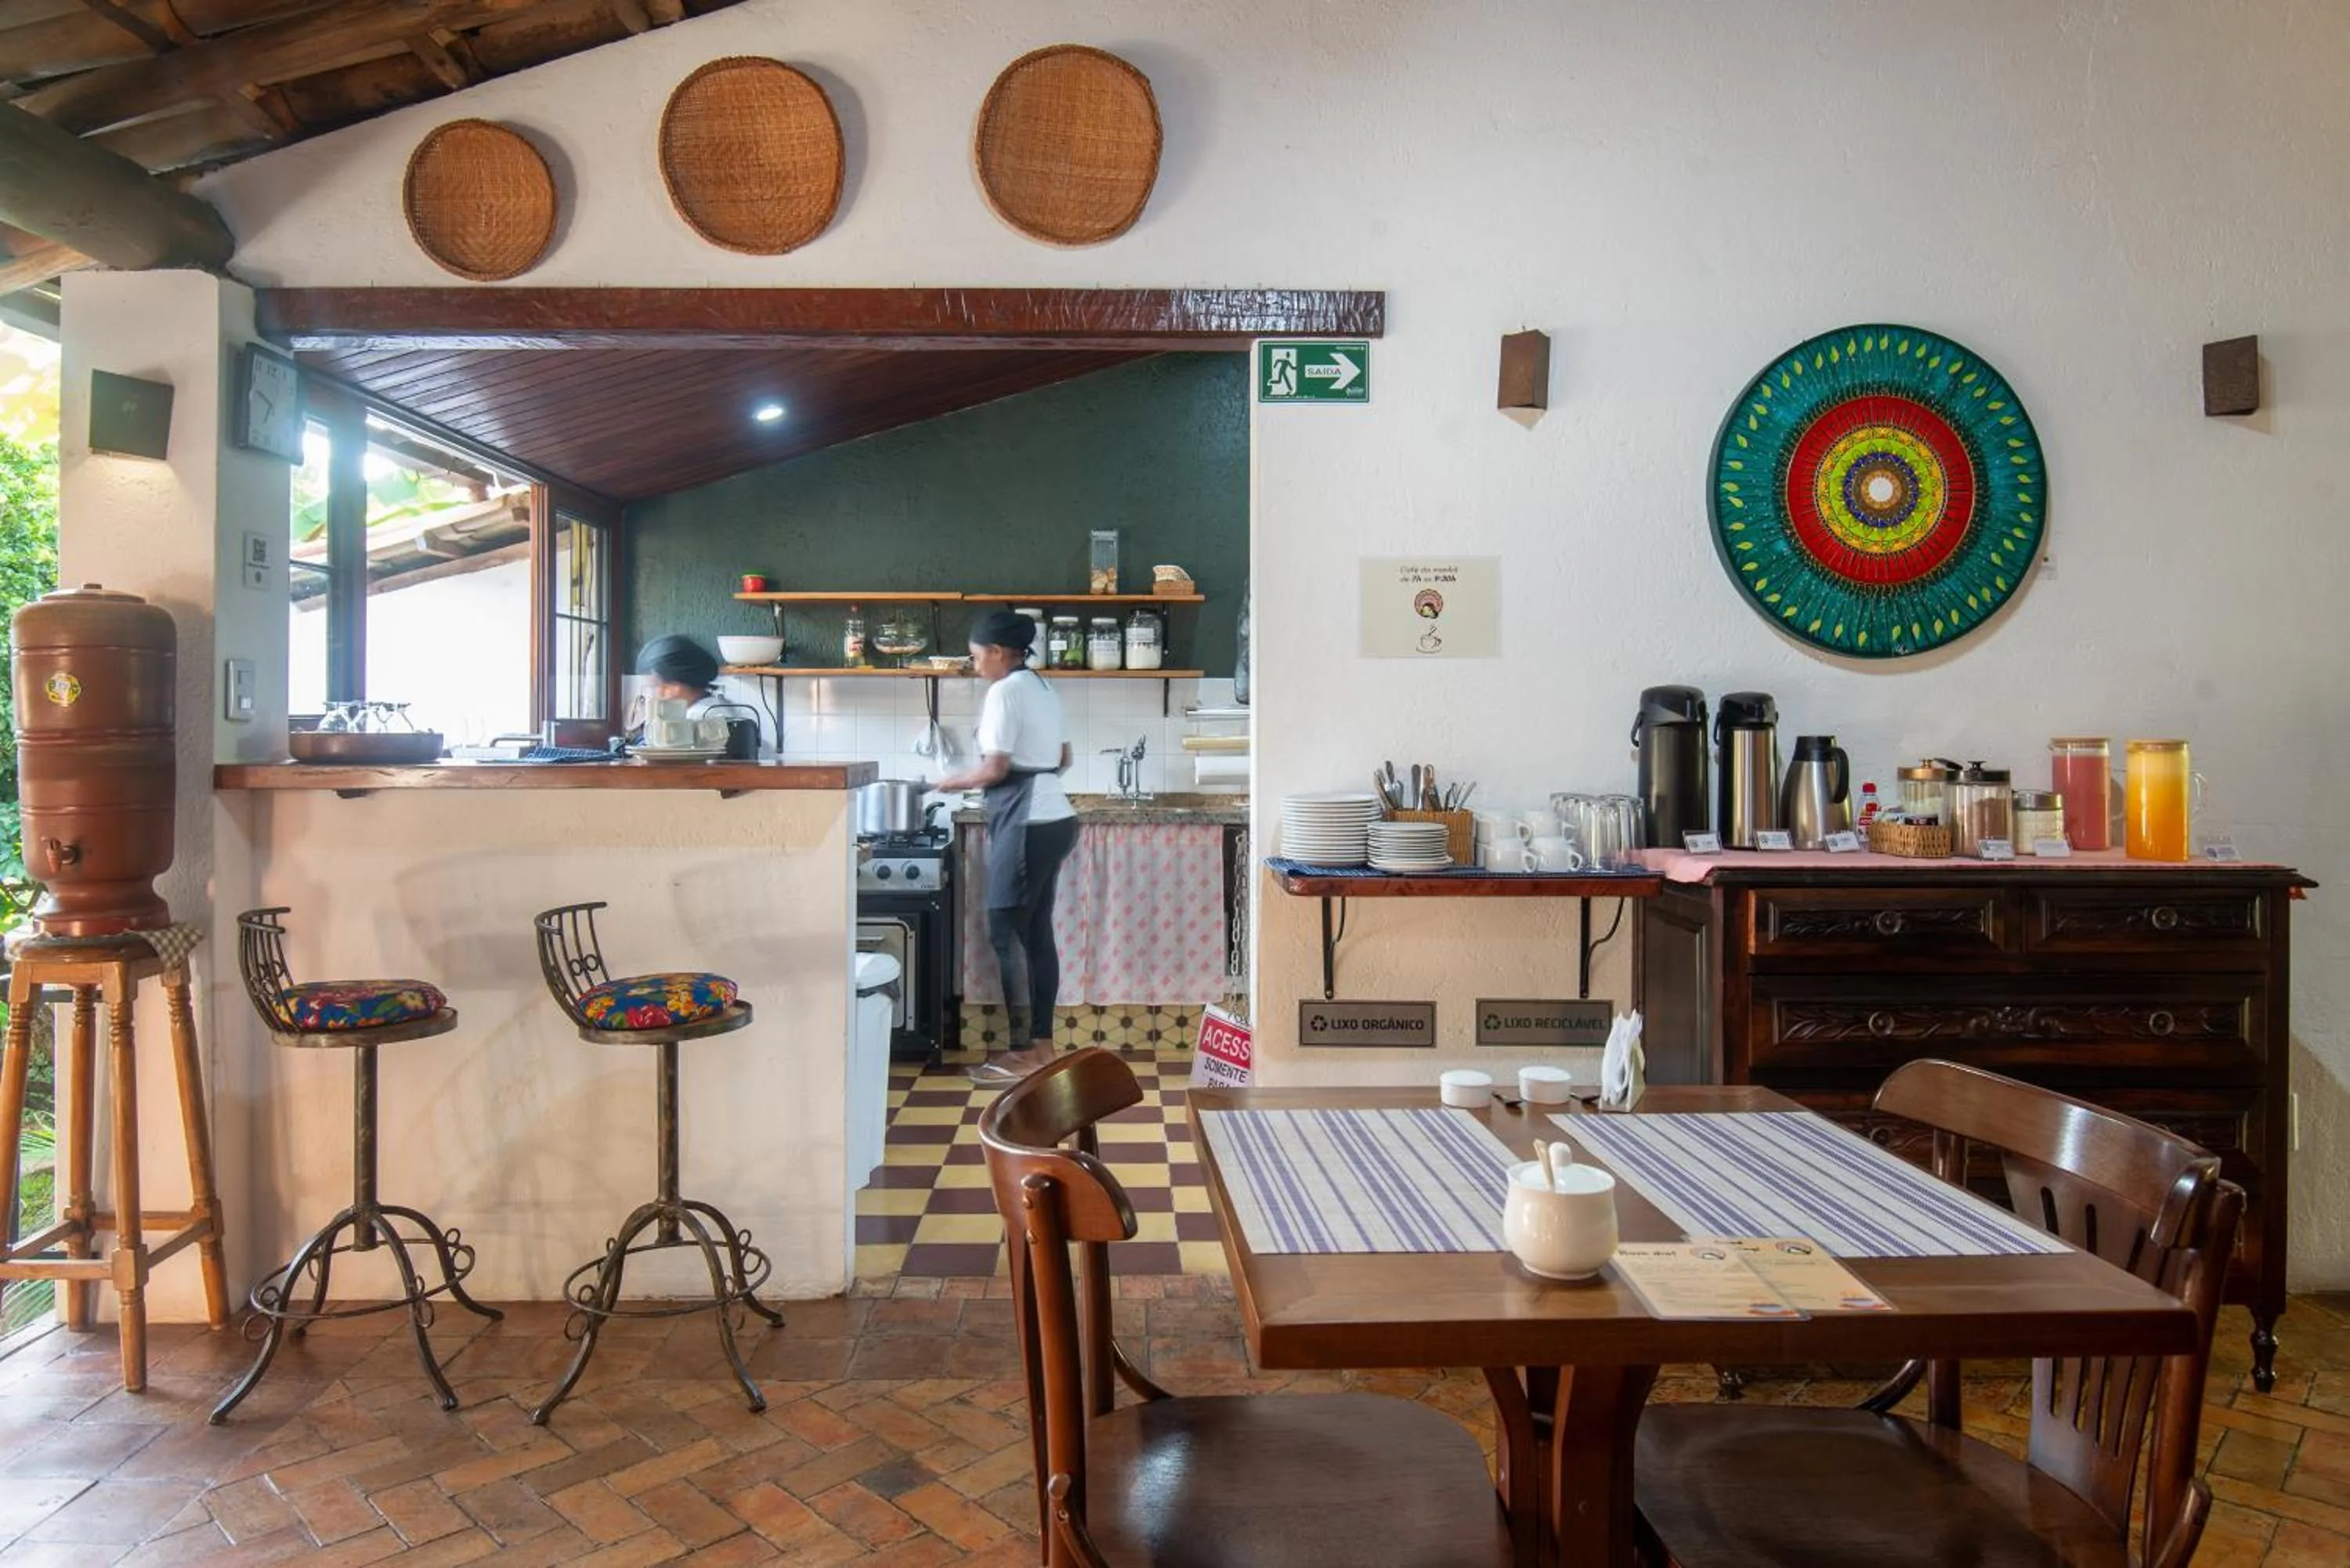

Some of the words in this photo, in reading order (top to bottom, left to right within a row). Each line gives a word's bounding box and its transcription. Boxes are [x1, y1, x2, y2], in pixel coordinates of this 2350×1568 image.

[1331, 1018, 1358, 1030] LIXO
[1361, 1017, 1425, 1031] ORGÂNICO
[1504, 1017, 1532, 1029] LIXO
[1202, 1024, 1251, 1061] ACESS
[1204, 1057, 1248, 1083] SOMENTE
